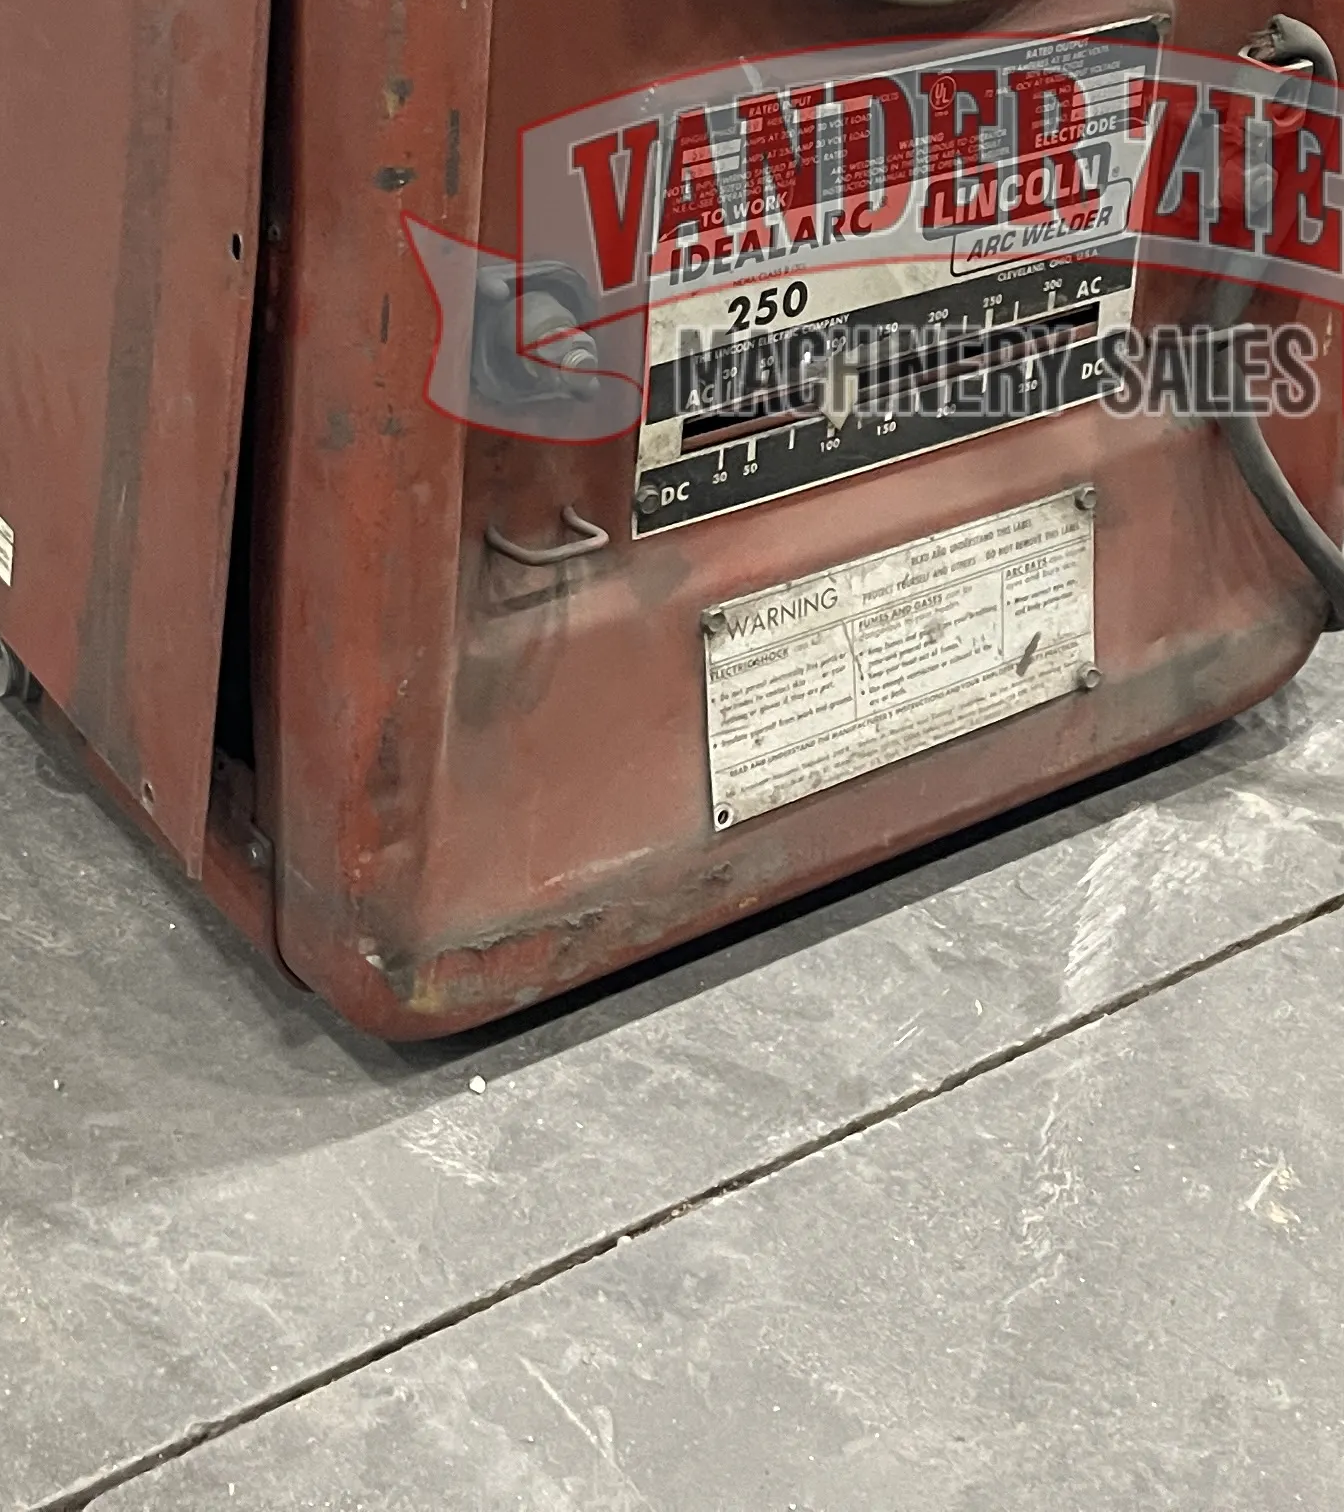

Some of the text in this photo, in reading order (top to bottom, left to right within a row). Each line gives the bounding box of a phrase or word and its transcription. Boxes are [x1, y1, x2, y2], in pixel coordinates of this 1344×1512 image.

[1026, 45, 1054, 59] RATED
[748, 102, 780, 118] RATED
[935, 82, 949, 104] UL
[1034, 115, 1117, 149] ELECTRODE
[700, 207, 727, 228] TO
[733, 191, 788, 220] WORK
[933, 152, 1102, 229] LINCOLN
[669, 200, 873, 286] IDEALARC
[966, 205, 1114, 263] ARC WELDER
[997, 260, 1046, 283] CLEVELAND,
[724, 280, 808, 336] 250
[801, 314, 851, 333] COMPANY
[686, 383, 715, 409] AC
[721, 365, 738, 380] 30
[878, 321, 899, 337] 150
[927, 308, 949, 324] 200
[983, 293, 1003, 309] 250
[1042, 278, 1063, 293] 300
[1075, 276, 1103, 300] AC
[660, 481, 691, 507] DC
[711, 471, 728, 485] 30
[742, 462, 759, 477] 50
[820, 437, 842, 453] 100
[876, 421, 898, 436] 150
[1017, 379, 1039, 394] 250
[1080, 357, 1105, 380] DC
[725, 587, 840, 641] WARNING
[859, 612, 889, 632] FUMES
[890, 604, 912, 621] AND
[914, 593, 943, 610] GASES
[754, 648, 789, 666] SHOCK
